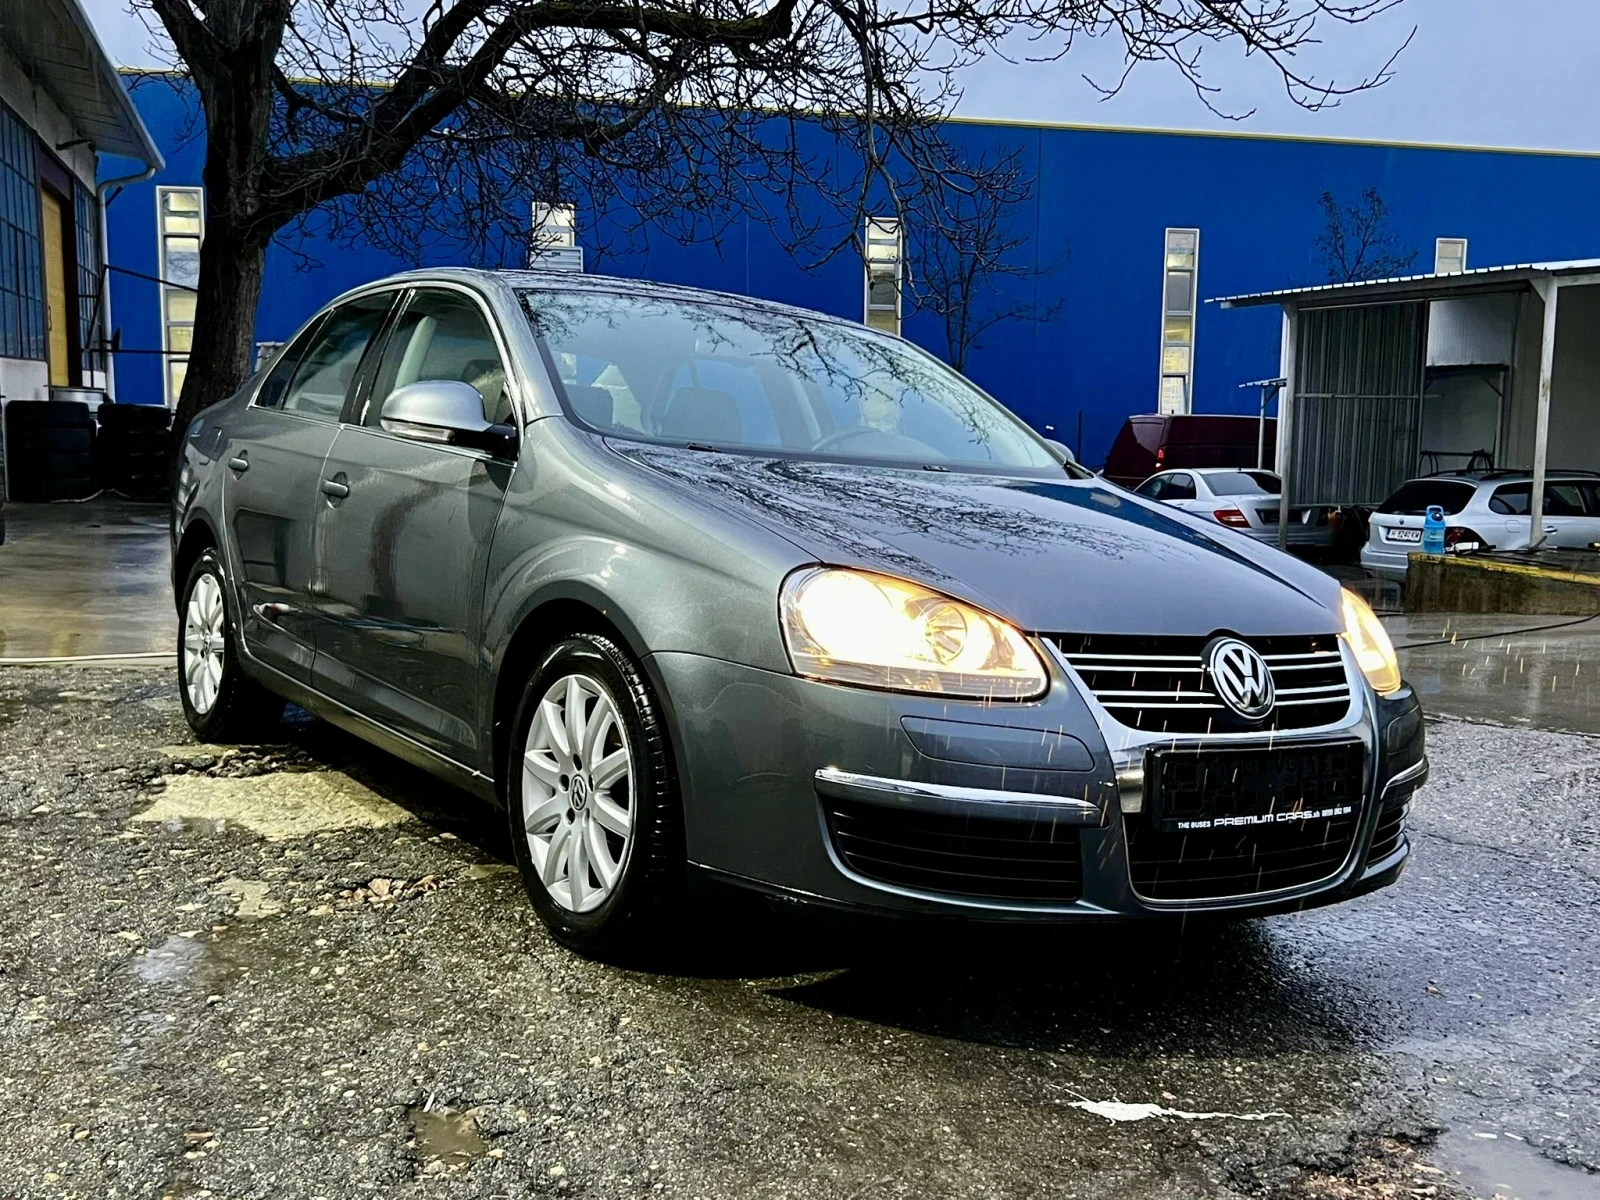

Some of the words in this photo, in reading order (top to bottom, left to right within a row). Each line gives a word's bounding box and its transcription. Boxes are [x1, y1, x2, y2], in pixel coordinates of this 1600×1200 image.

[1177, 821, 1189, 829] THE
[1190, 820, 1211, 829] BUSES
[1213, 813, 1274, 827] PREMIUM
